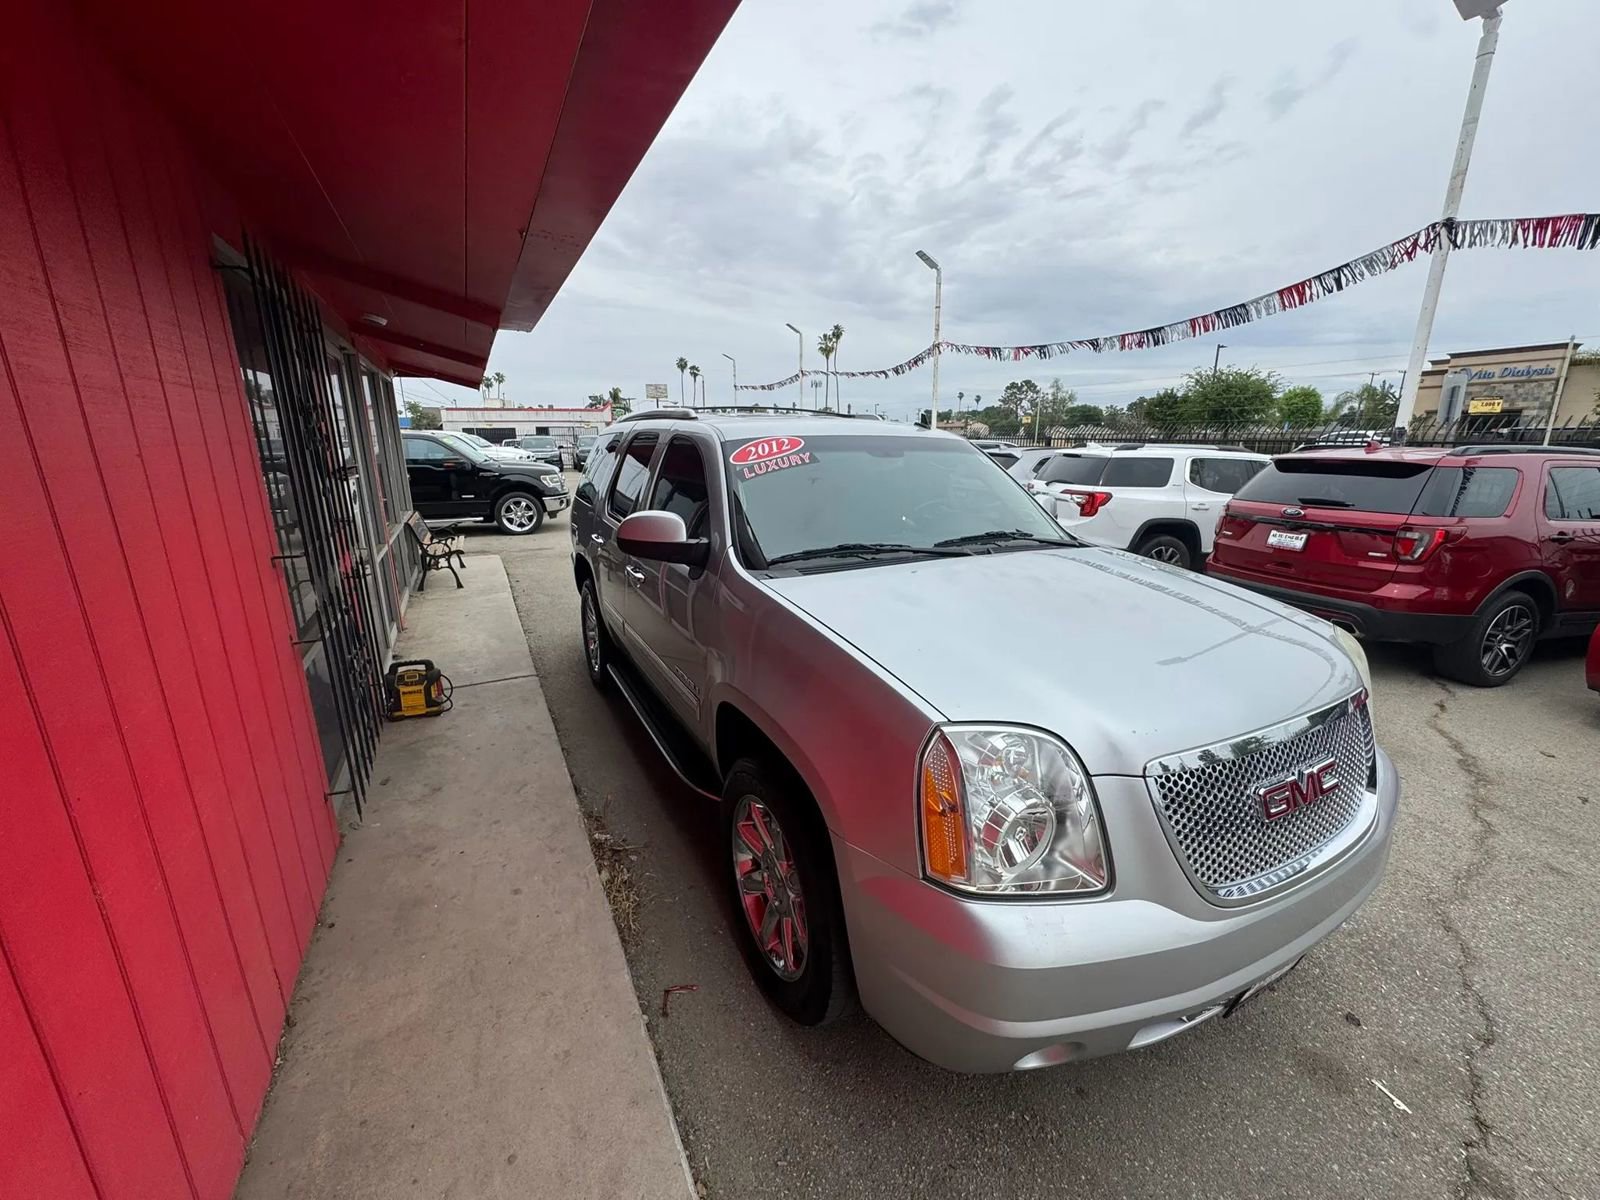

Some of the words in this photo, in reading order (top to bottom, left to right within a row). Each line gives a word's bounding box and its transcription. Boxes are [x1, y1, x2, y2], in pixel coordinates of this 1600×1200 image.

[1498, 364, 1556, 379] Dialysis
[745, 438, 791, 461] 2012
[743, 452, 810, 480] LUXURY
[1259, 757, 1341, 822] GMC
